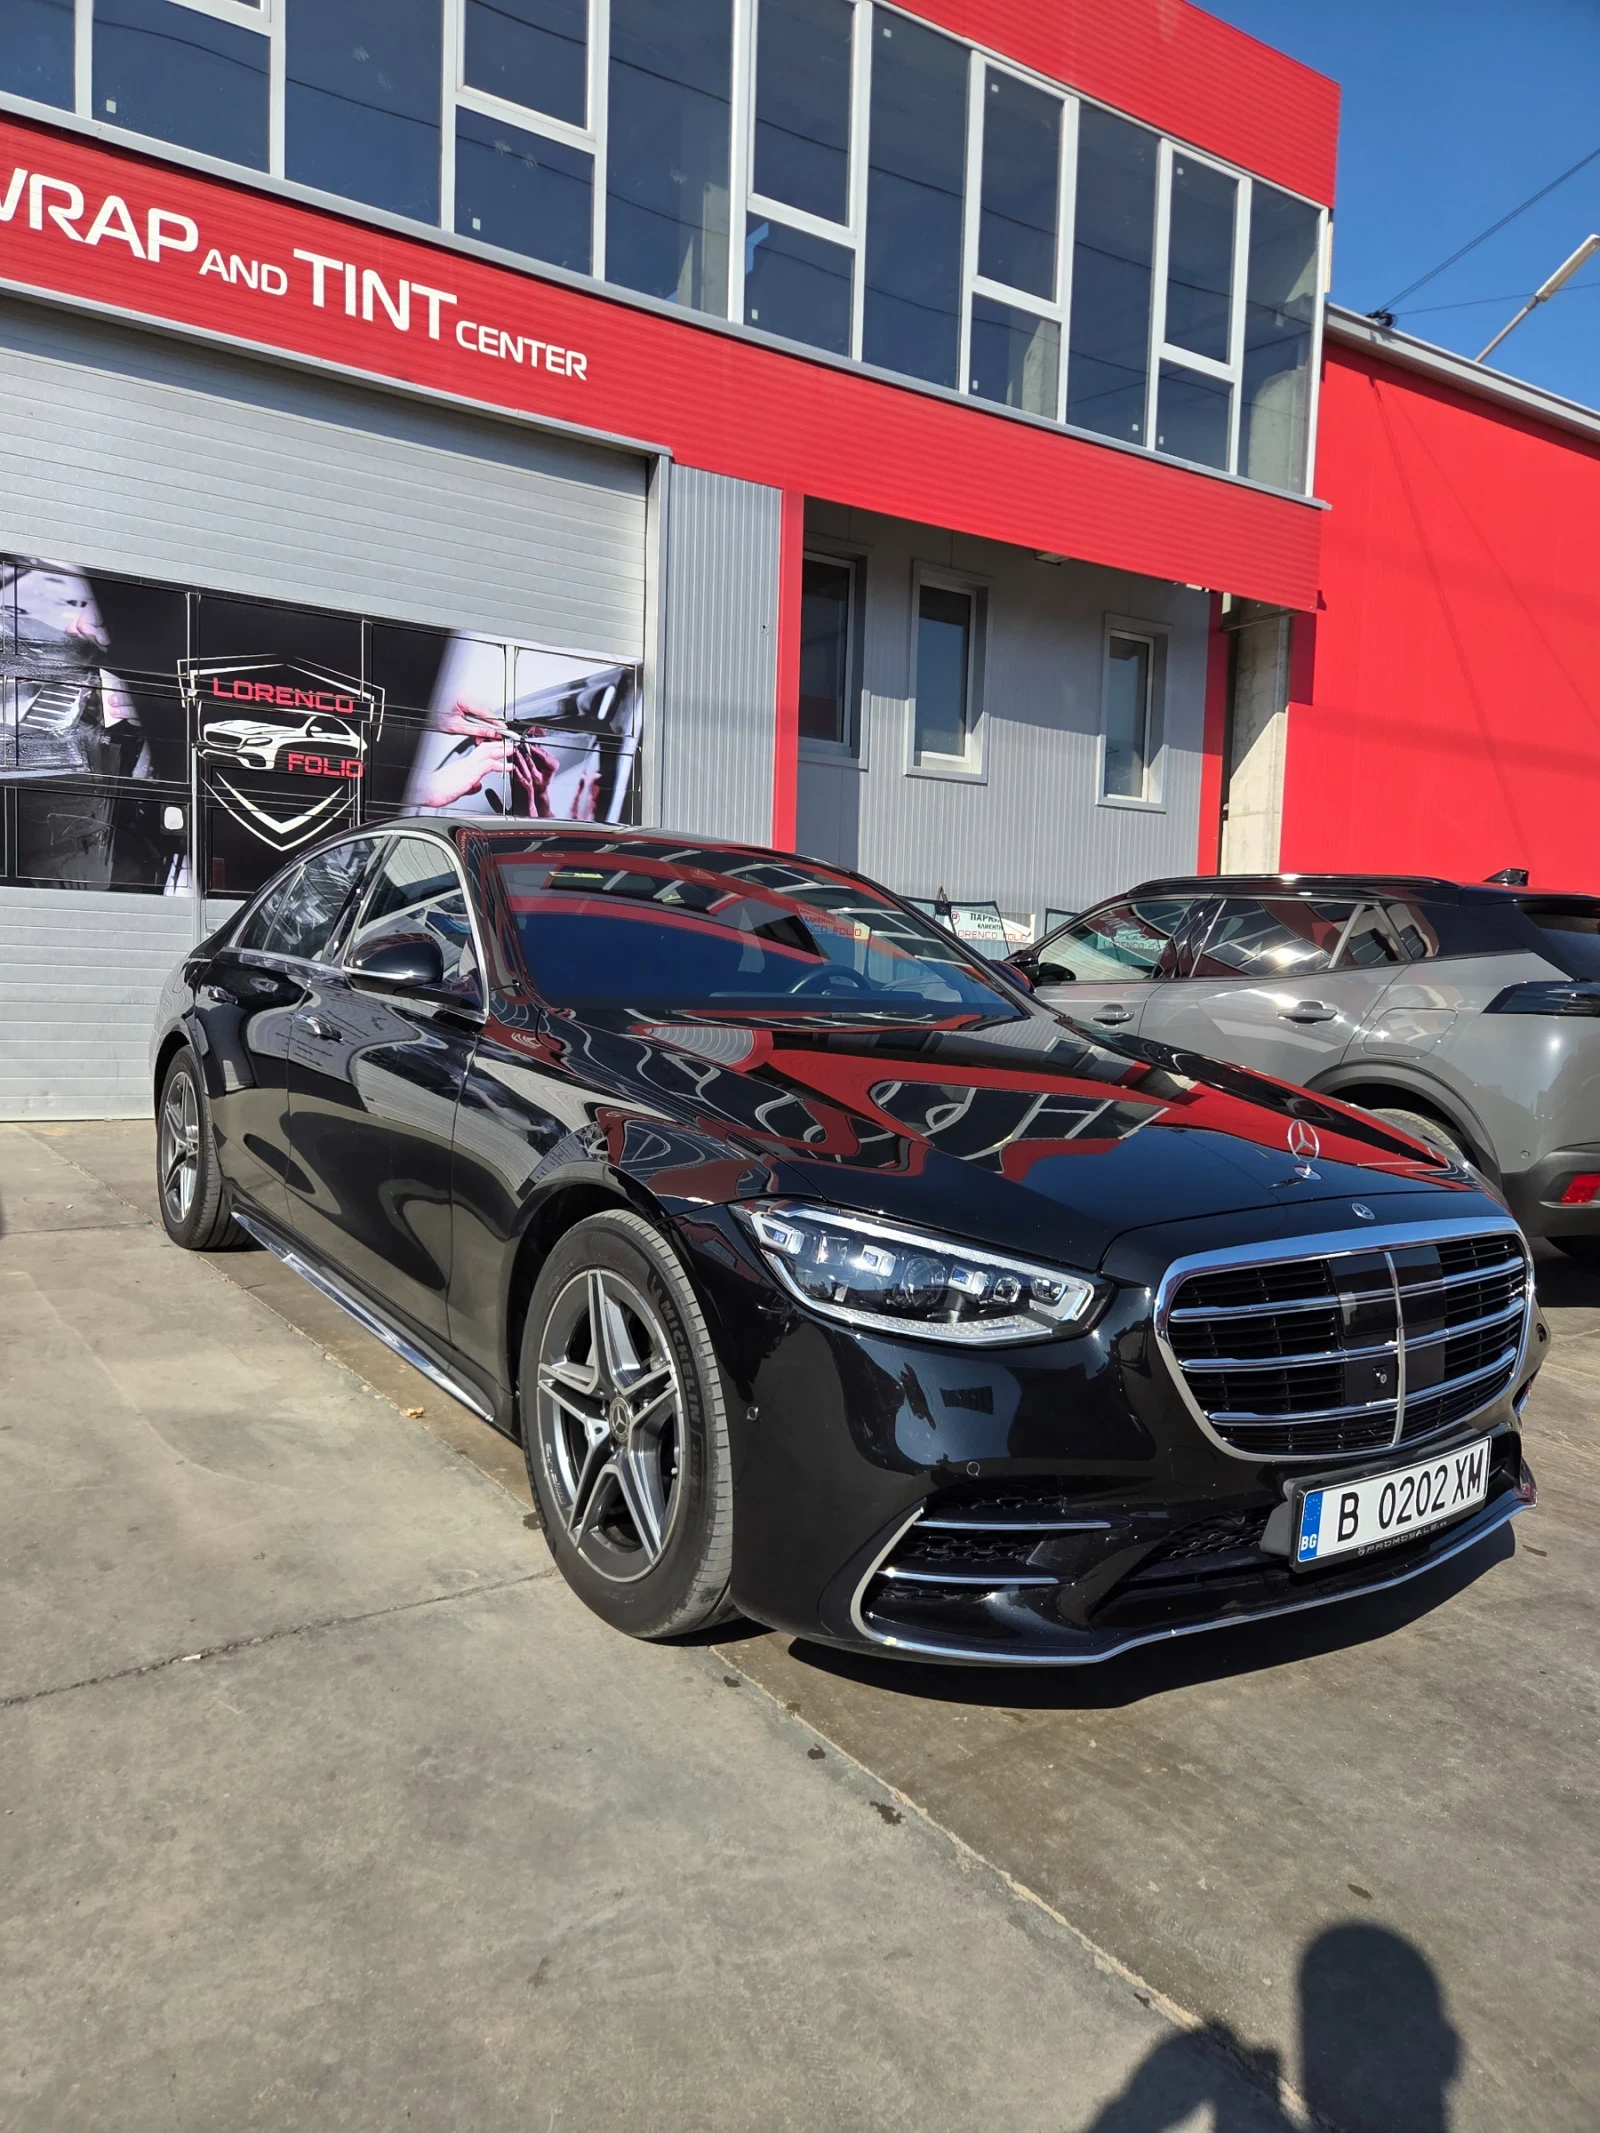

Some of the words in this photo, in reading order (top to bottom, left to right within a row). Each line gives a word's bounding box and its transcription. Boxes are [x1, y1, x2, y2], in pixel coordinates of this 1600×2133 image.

[199, 248, 288, 296] AND
[293, 247, 457, 341] TINT
[455, 320, 588, 381] CENTER
[213, 677, 353, 713] LORENCO
[288, 753, 364, 778] FOLIO
[958, 930, 998, 939] ORENCO
[660, 1300, 701, 1427] MICHELIN
[1337, 1491, 1360, 1543] B
[1378, 1464, 1449, 1530] 0202
[1451, 1448, 1484, 1505] XM
[1301, 1533, 1317, 1551] BG
